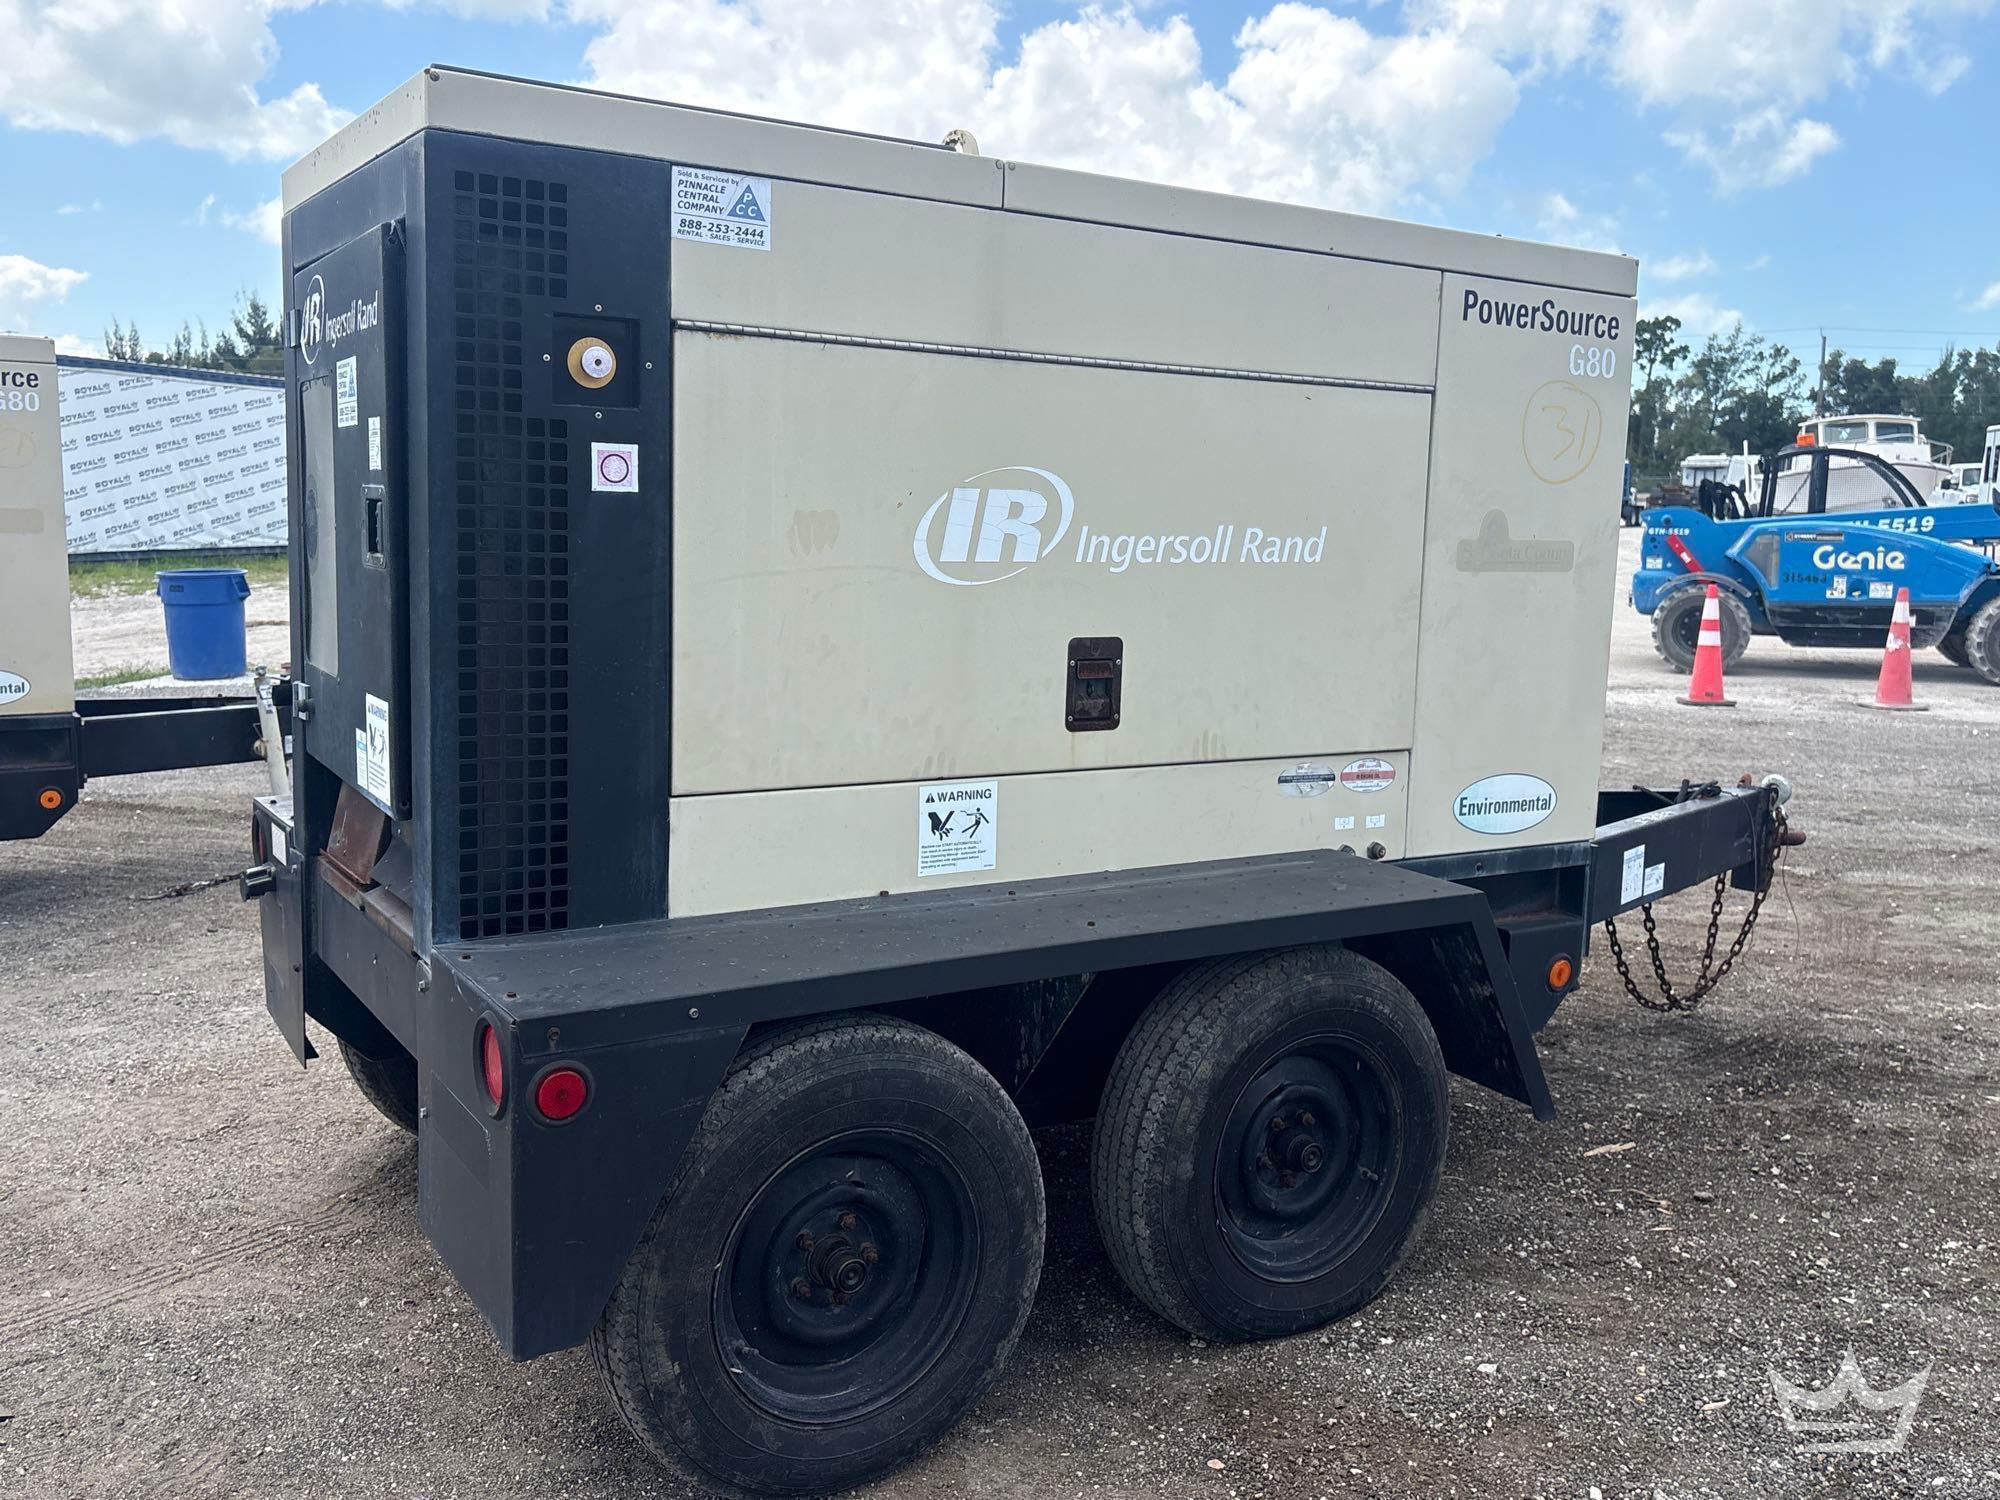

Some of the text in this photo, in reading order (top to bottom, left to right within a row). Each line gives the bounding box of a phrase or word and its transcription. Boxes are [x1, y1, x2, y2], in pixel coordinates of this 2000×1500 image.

[678, 170, 692, 178] Sold
[701, 174, 730, 184] Serviced
[731, 177, 739, 186] by
[678, 179, 726, 194] PINNACLE
[678, 190, 720, 204] CENTRAL
[743, 192, 753, 203] P
[677, 200, 725, 214] COMPANY
[679, 218, 764, 239] 888-253-2444
[677, 229, 703, 238] RENTAL
[710, 233, 730, 242] SALES
[737, 237, 766, 246] SERVICE
[325, 300, 356, 348] Ingersoll
[356, 290, 378, 332] Rand
[1462, 289, 1620, 340] PowerSource
[1568, 344, 1617, 379] G80
[74, 384, 103, 395] ROYAL
[186, 387, 208, 397] ROYAL
[146, 395, 172, 405] ROYAL
[244, 397, 267, 407] ROYAL
[104, 404, 131, 414] ROYAL
[208, 405, 232, 415] ROYAL
[170, 413, 195, 424] ROYAL
[129, 422, 155, 432] ROYAL
[232, 422, 256, 432] ROYAL
[86, 431, 114, 442] ROYAL
[195, 430, 220, 440] ROYAL
[156, 438, 181, 449] ROYAL
[253, 438, 275, 448] ROYAL
[114, 449, 140, 460] ROYAL
[217, 447, 241, 458] ROYAL
[70, 459, 98, 471] ROYAL
[179, 456, 205, 467] ROYAL
[139, 467, 165, 477] ROYAL
[240, 463, 265, 473] ROYAL
[95, 477, 121, 488] ROYAL
[203, 473, 228, 483] ROYAL
[261, 479, 282, 488] ROYAL
[165, 482, 190, 494] ROYAL
[225, 488, 248, 499] ROYAL
[123, 493, 150, 505] ROYAL
[188, 499, 212, 510] ROYAL
[80, 505, 107, 517] ROYAL
[248, 503, 269, 514] ROYAL
[148, 509, 172, 521] ROYAL
[211, 514, 234, 525] ROYAL
[105, 522, 132, 534] ROYAL
[174, 525, 197, 537] ROYAL
[939, 487, 1328, 573] IR Ingersoll Rand
[231, 530, 253, 540] ROYAL
[1813, 545, 1905, 570] Genie
[937, 788, 992, 802] WARNING
[1458, 794, 1552, 816] Environmental
